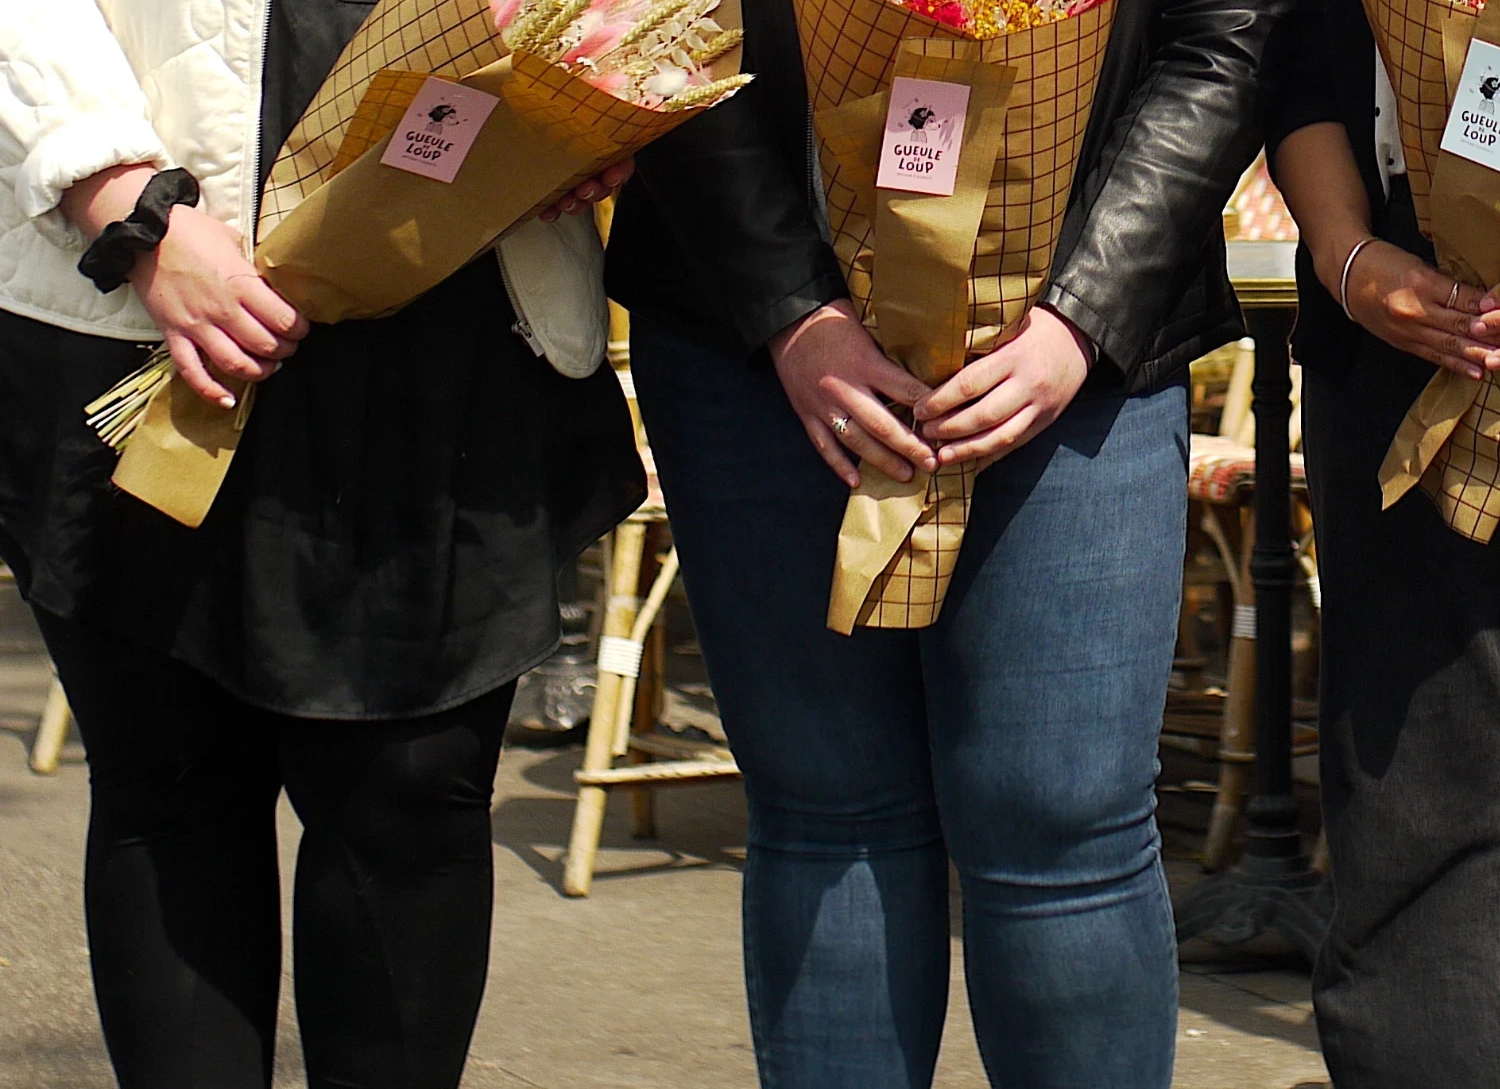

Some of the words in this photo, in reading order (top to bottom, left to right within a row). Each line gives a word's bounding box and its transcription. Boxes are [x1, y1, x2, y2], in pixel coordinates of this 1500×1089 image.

[405, 131, 454, 152] GUEULE
[1463, 125, 1497, 146] LOUP
[406, 143, 442, 161] LOUP
[894, 144, 943, 161] GUEULE
[898, 157, 934, 173] LOUP
